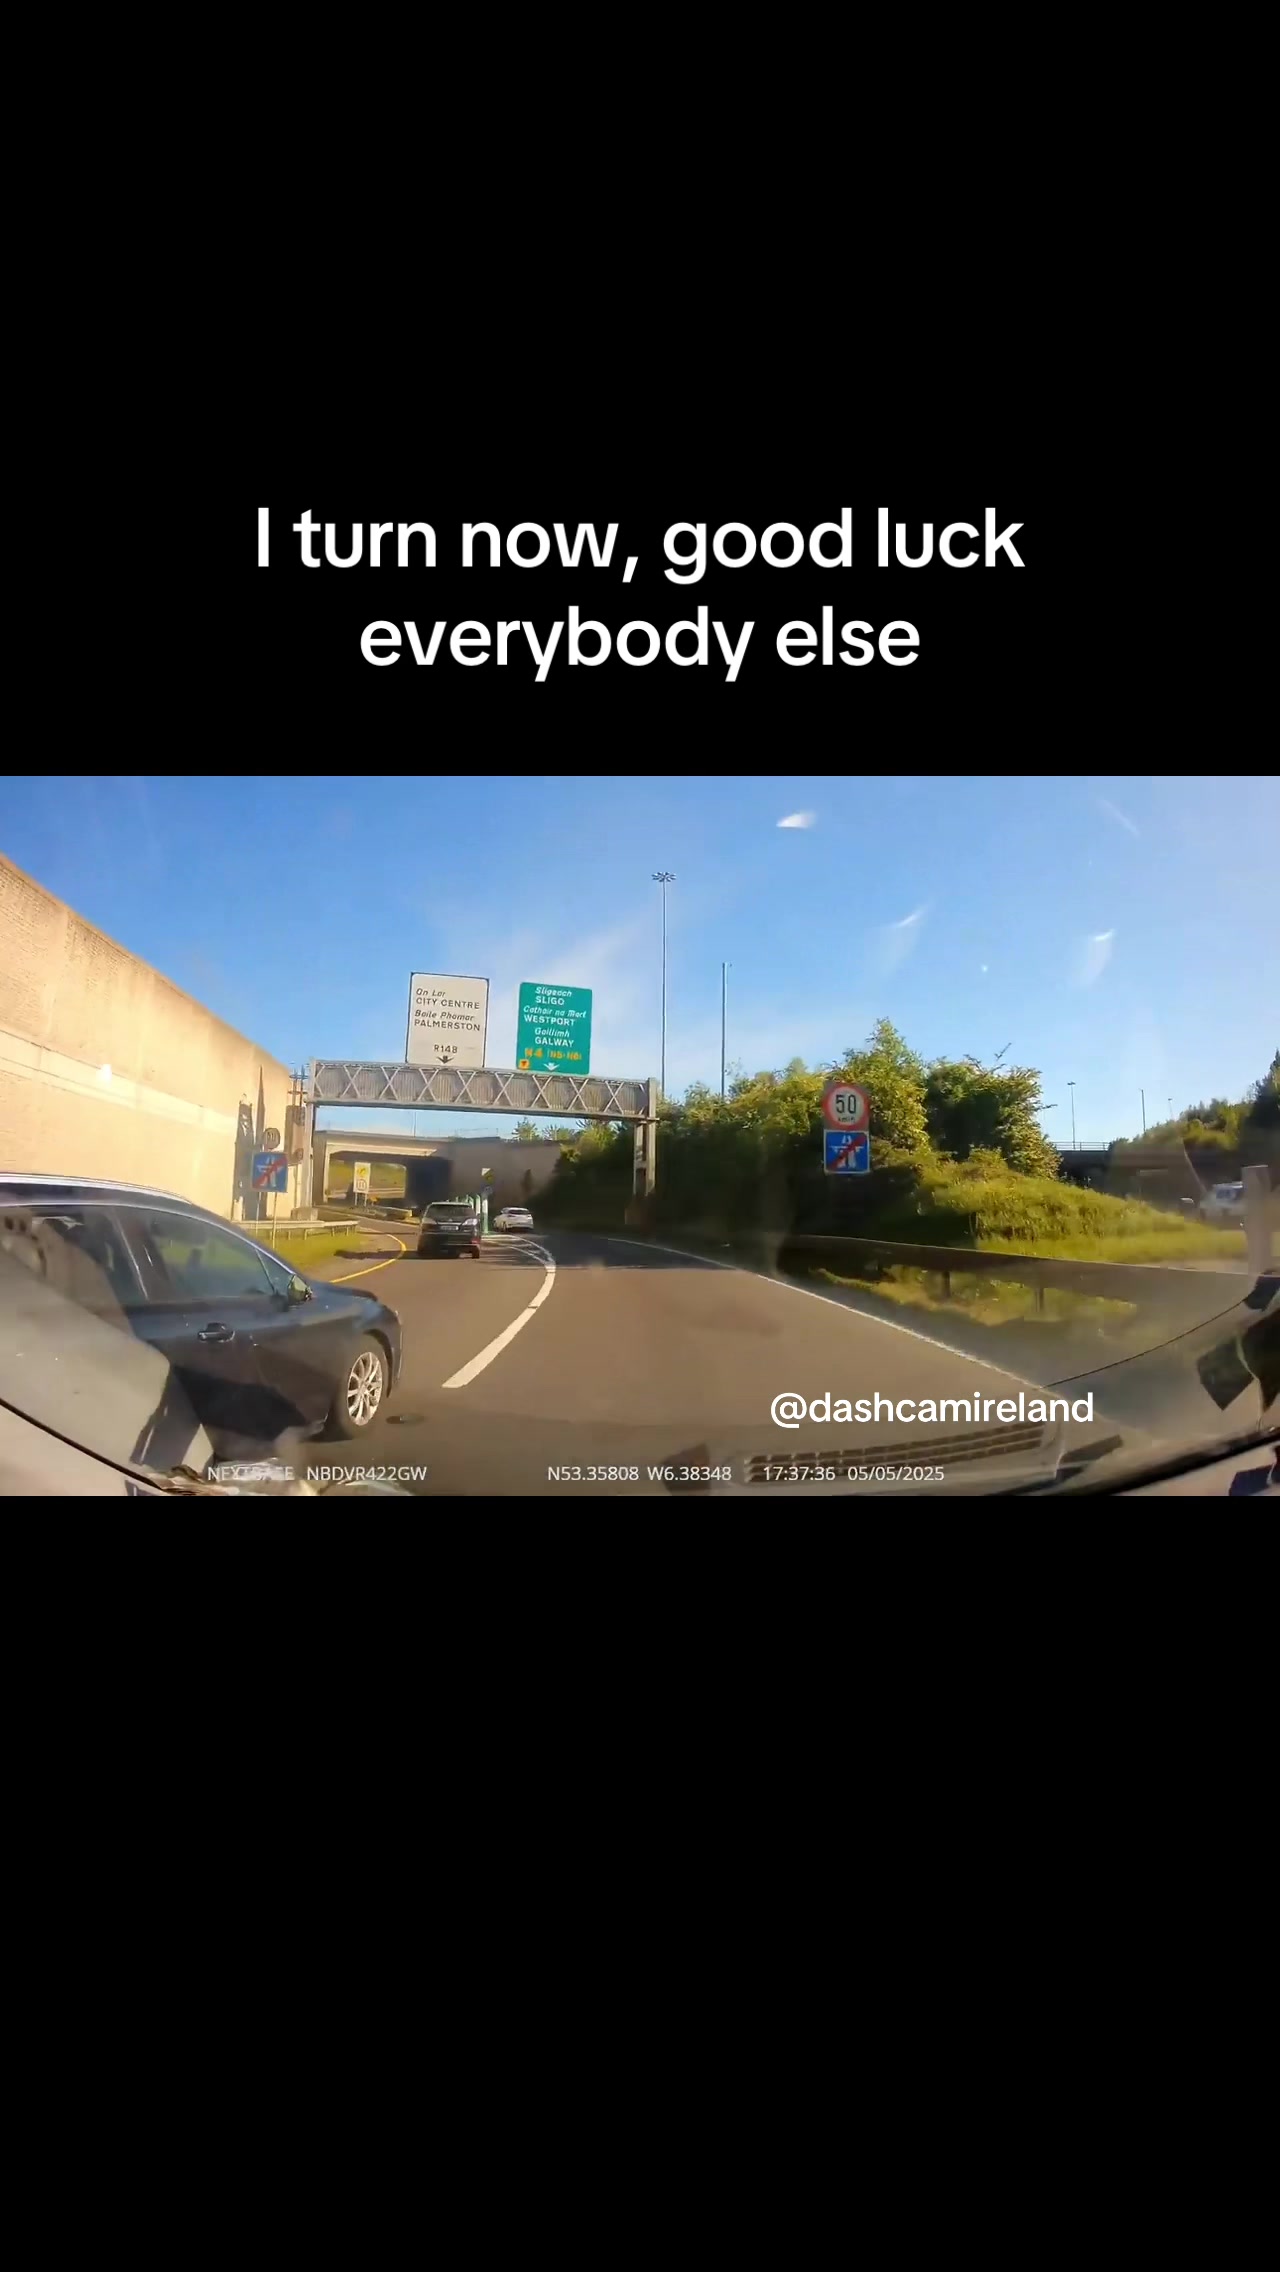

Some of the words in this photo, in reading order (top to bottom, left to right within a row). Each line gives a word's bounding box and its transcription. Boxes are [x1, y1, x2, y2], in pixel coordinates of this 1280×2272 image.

[416, 997, 438, 1006] CITY
[440, 999, 480, 1010] CENTRE
[535, 995, 565, 1006] SLIGO
[414, 1018, 481, 1032] PALMERSTON
[523, 1014, 576, 1027] WESTPORT
[534, 1036, 575, 1048] GALWAY
[434, 1044, 458, 1054] R148
[835, 1094, 857, 1114] 50
